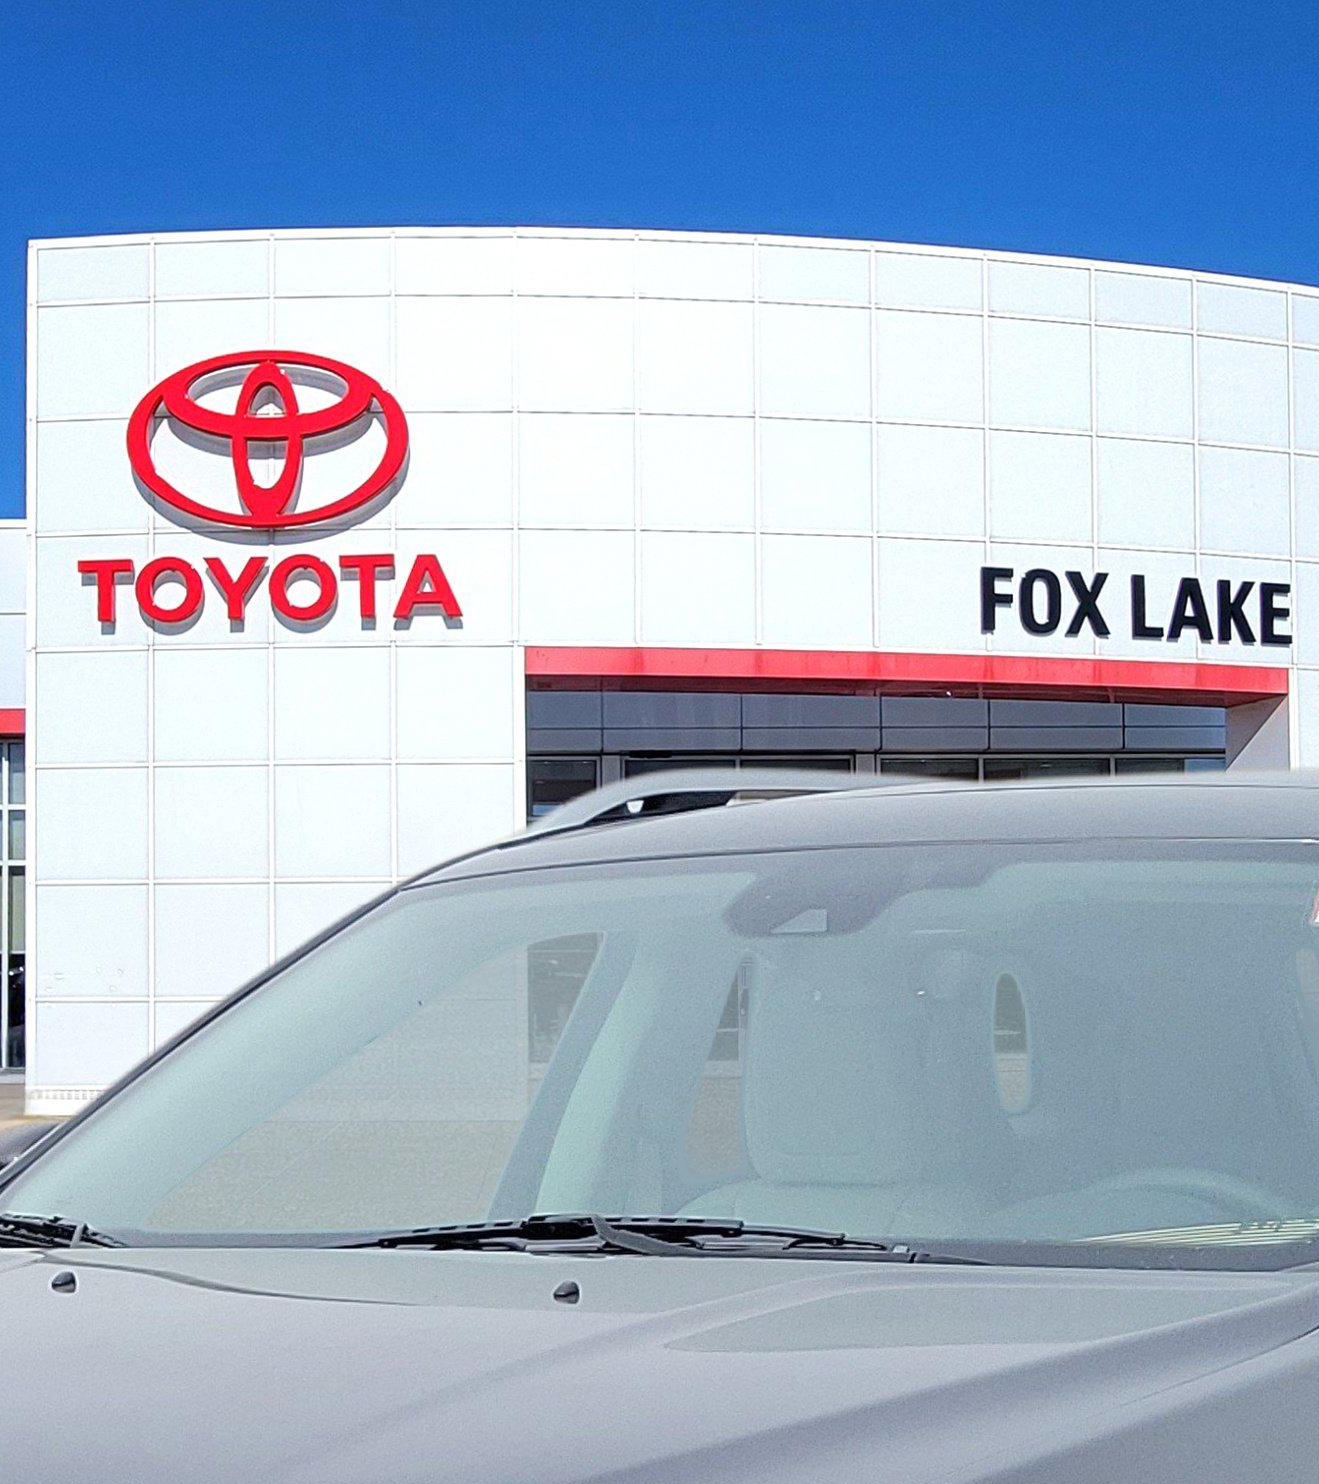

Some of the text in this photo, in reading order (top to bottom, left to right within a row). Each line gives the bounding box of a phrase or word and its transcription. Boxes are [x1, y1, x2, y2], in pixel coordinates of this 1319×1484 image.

[77, 553, 464, 626] TOYOTA
[981, 566, 1293, 645] FOX LAKE
